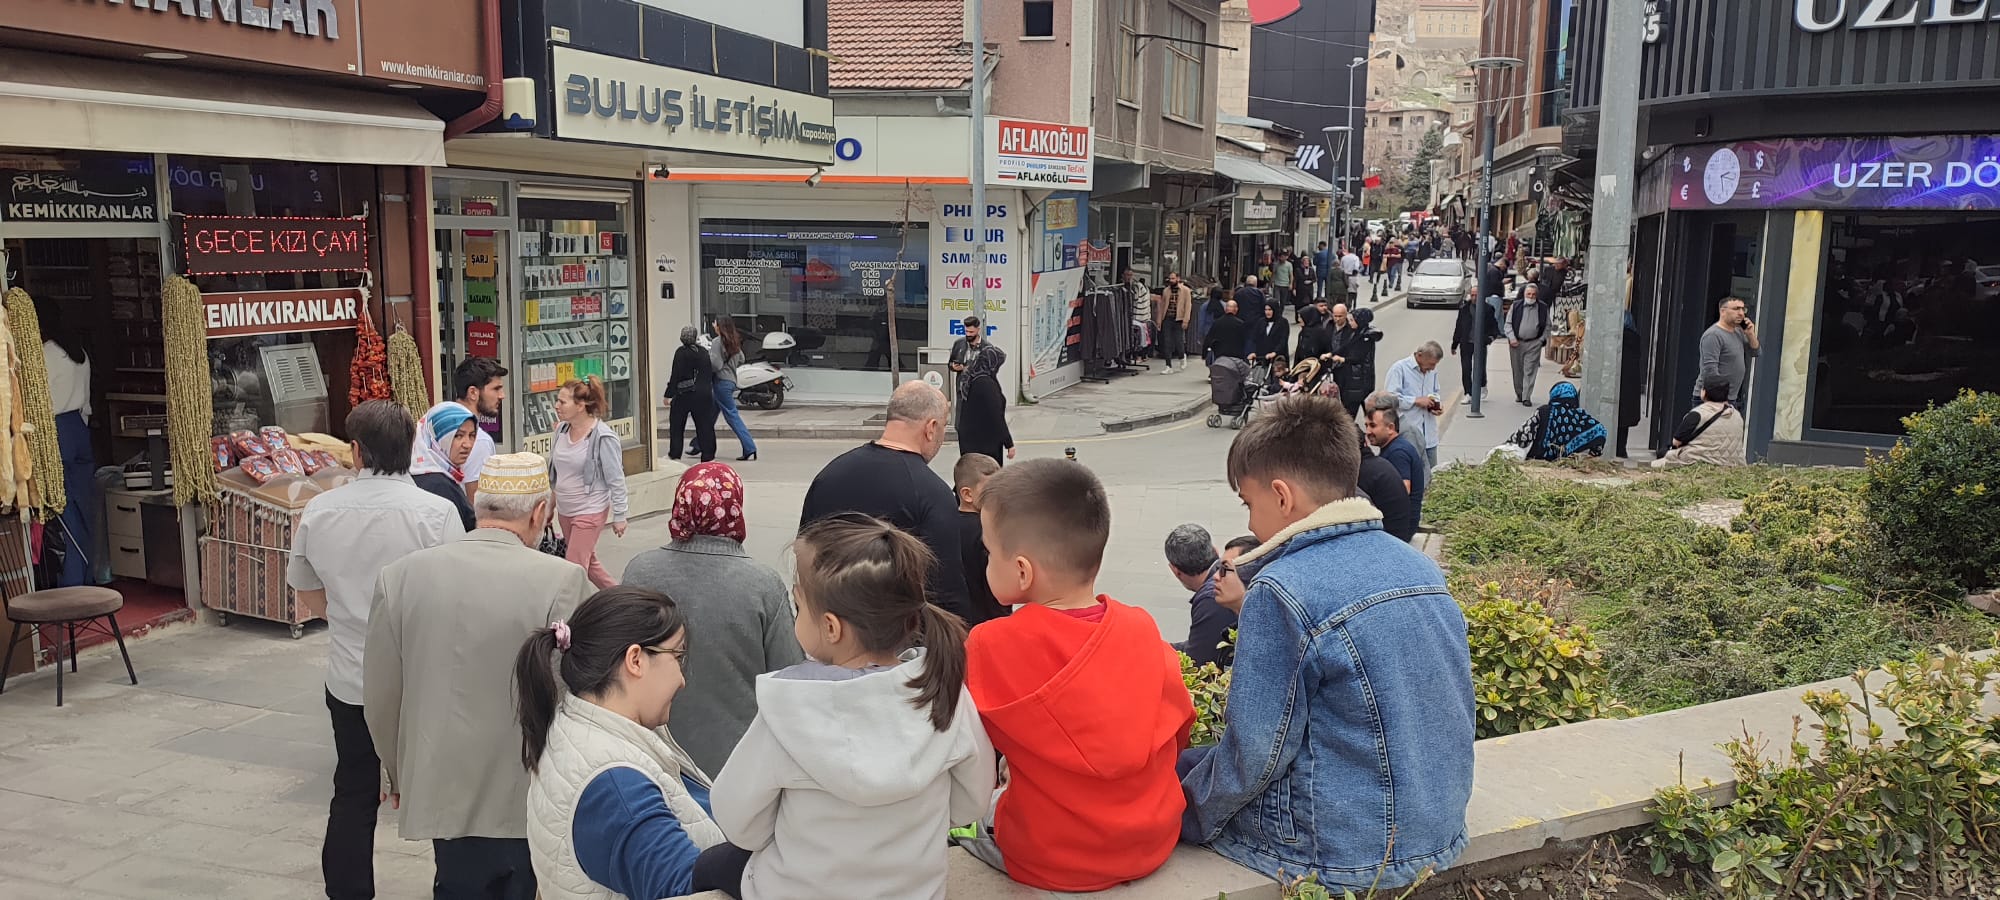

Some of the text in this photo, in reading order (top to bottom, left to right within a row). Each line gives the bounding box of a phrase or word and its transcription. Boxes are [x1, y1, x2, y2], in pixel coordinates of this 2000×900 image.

[381, 60, 484, 86] www.kemikkiranlar.com
[566, 74, 800, 144] BULUŞ İLETİŞİM
[802, 125, 835, 143] kapadokya
[1001, 127, 1086, 157] AFLAKOĞLU
[1026, 162, 1047, 170] PHILIPS
[1067, 165, 1085, 174] Tefal
[1017, 172, 1069, 183] AFLAKOĞLU
[1833, 162, 1932, 188] UZER
[8, 200, 153, 219] KEMİKKIRANLAR
[944, 204, 1007, 218] PHIPS
[964, 228, 1004, 242] UUR
[195, 230, 265, 254] GECE
[312, 230, 358, 257] ÇAYI
[471, 254, 488, 266] ŞARJ
[942, 253, 1007, 264] SAMNG
[725, 268, 760, 276] PROGRAM
[869, 270, 880, 278] KG
[725, 276, 760, 284] PROGRAM
[869, 279, 880, 287] KG
[962, 277, 1002, 289] AUS
[725, 285, 760, 293] PROGRAM
[873, 288, 884, 296] KG
[203, 297, 357, 329] EMİKKIRANLAR
